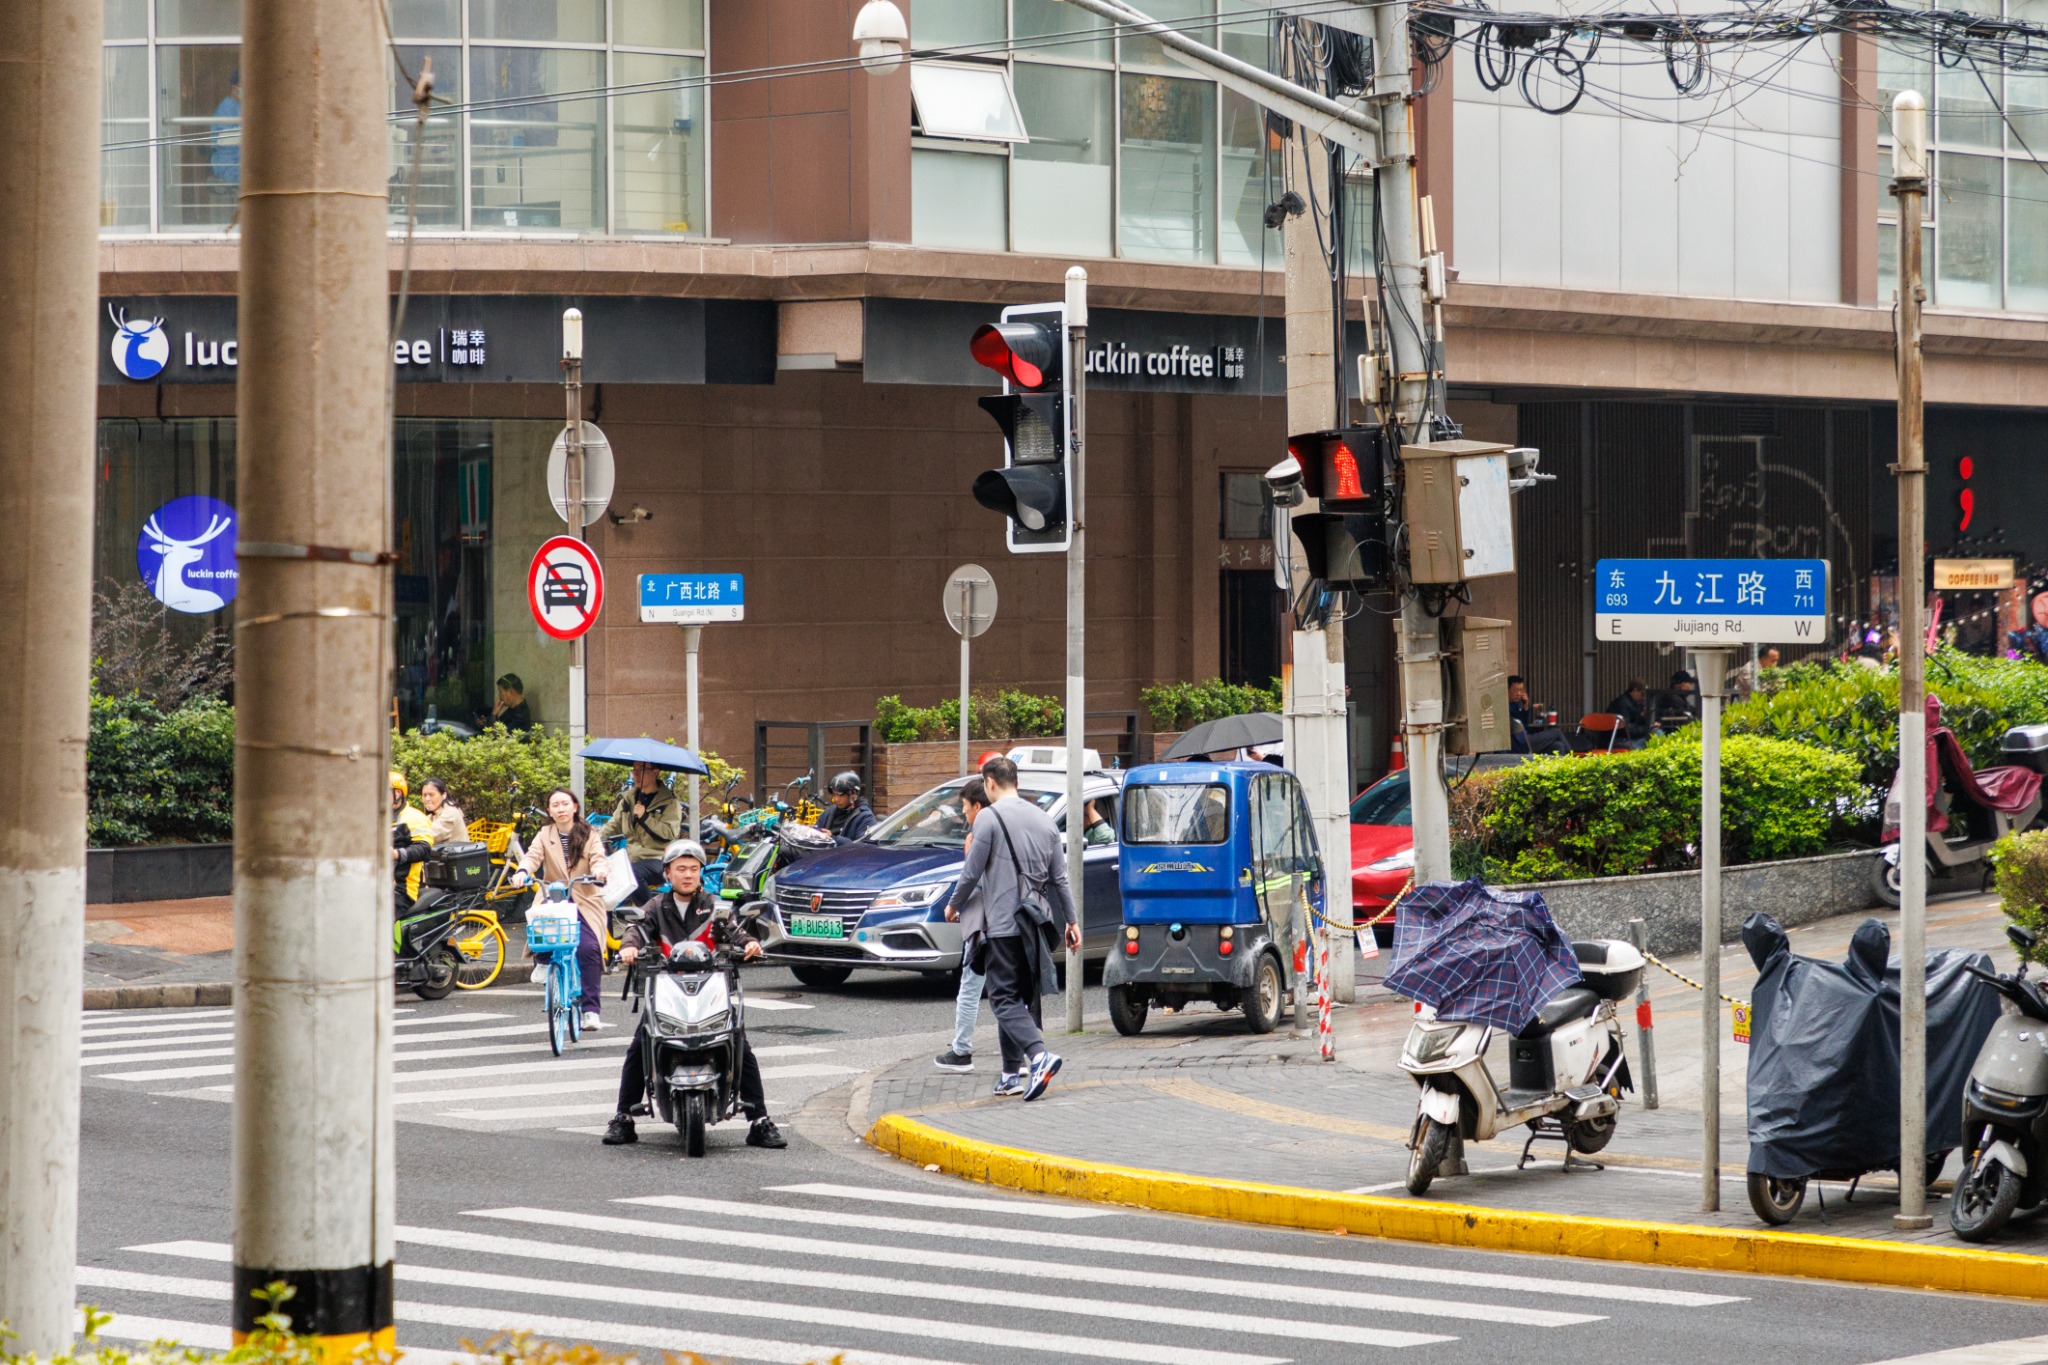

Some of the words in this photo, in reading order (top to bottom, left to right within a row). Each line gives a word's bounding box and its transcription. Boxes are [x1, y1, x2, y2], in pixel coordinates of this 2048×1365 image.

[452, 329, 485, 347] 瑞幸
[452, 348, 485, 365] 咖啡
[1085, 342, 1140, 375] uckin
[1146, 345, 1214, 377] coffee
[1224, 346, 1245, 362] 瑞幸
[1224, 363, 1245, 379] 咖啡
[187, 568, 214, 579] luckin
[215, 569, 239, 579] coffe
[1609, 568, 1626, 589] 东
[1795, 569, 1813, 590] 西
[1948, 573, 1980, 586] COFFEE
[1983, 573, 1999, 586] BAR
[647, 580, 656, 592] 北
[666, 581, 721, 601] 广西北路
[730, 580, 738, 592] 南
[1653, 570, 1767, 606] 九江路
[1606, 593, 1628, 607] 693
[1793, 594, 1814, 608] 711
[648, 609, 655, 619] N
[731, 607, 737, 617] S
[1611, 618, 1622, 635] E
[1673, 619, 1719, 636] Jiujiang
[1725, 619, 1745, 633] Rd.
[1794, 620, 1812, 637] W
